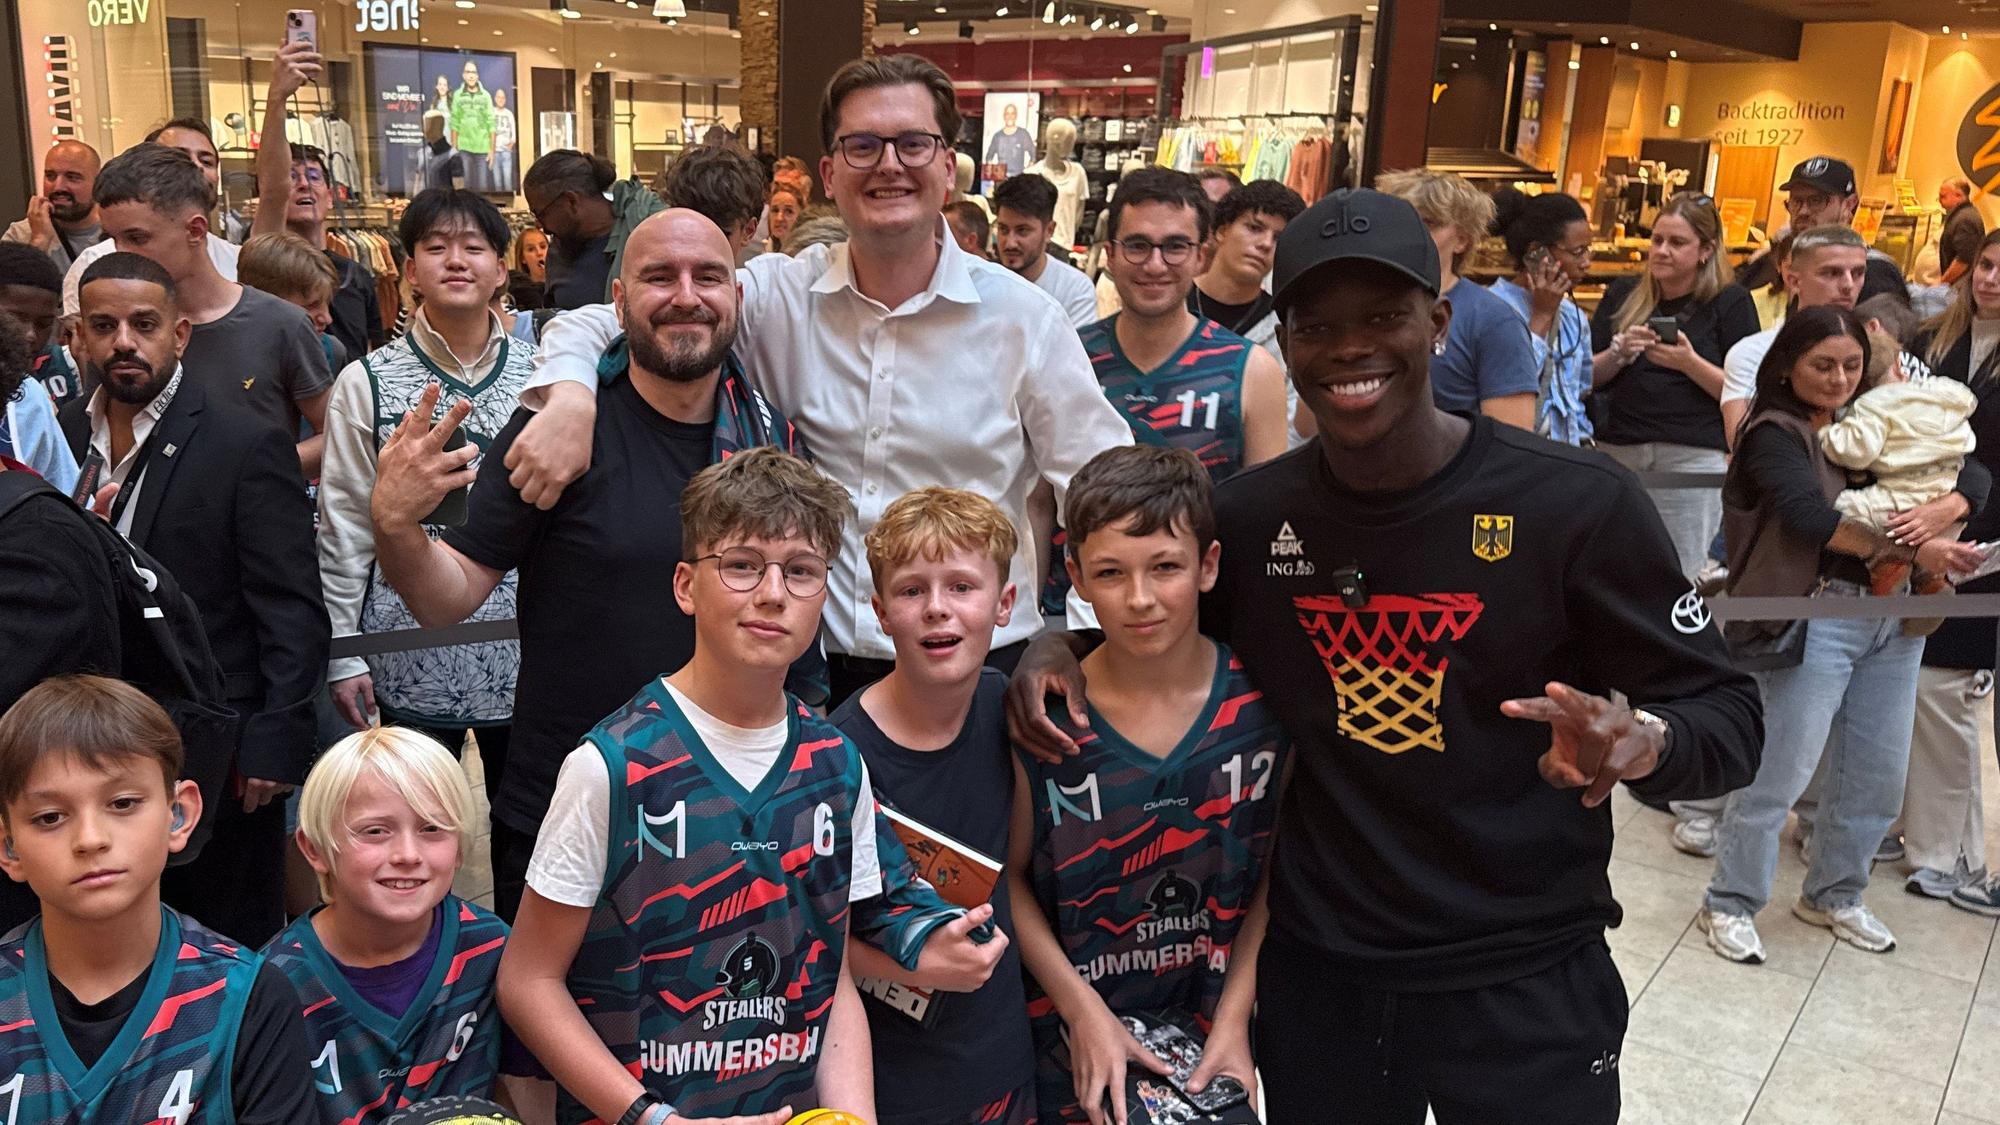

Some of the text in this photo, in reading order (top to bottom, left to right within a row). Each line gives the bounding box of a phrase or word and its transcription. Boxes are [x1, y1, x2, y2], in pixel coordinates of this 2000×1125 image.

[1717, 100, 1845, 119] Backtradition
[1756, 128, 1804, 146] 1927
[1321, 205, 1370, 238] alo
[1176, 389, 1220, 430] 11
[1270, 540, 1304, 556] PEAK
[1266, 562, 1293, 576] ING
[1221, 751, 1276, 804] 12
[813, 802, 835, 857] 6
[1136, 908, 1211, 944] STEALERS
[702, 996, 787, 1031] STEALERS
[445, 1010, 478, 1062] 6
[158, 1069, 195, 1125] 4
